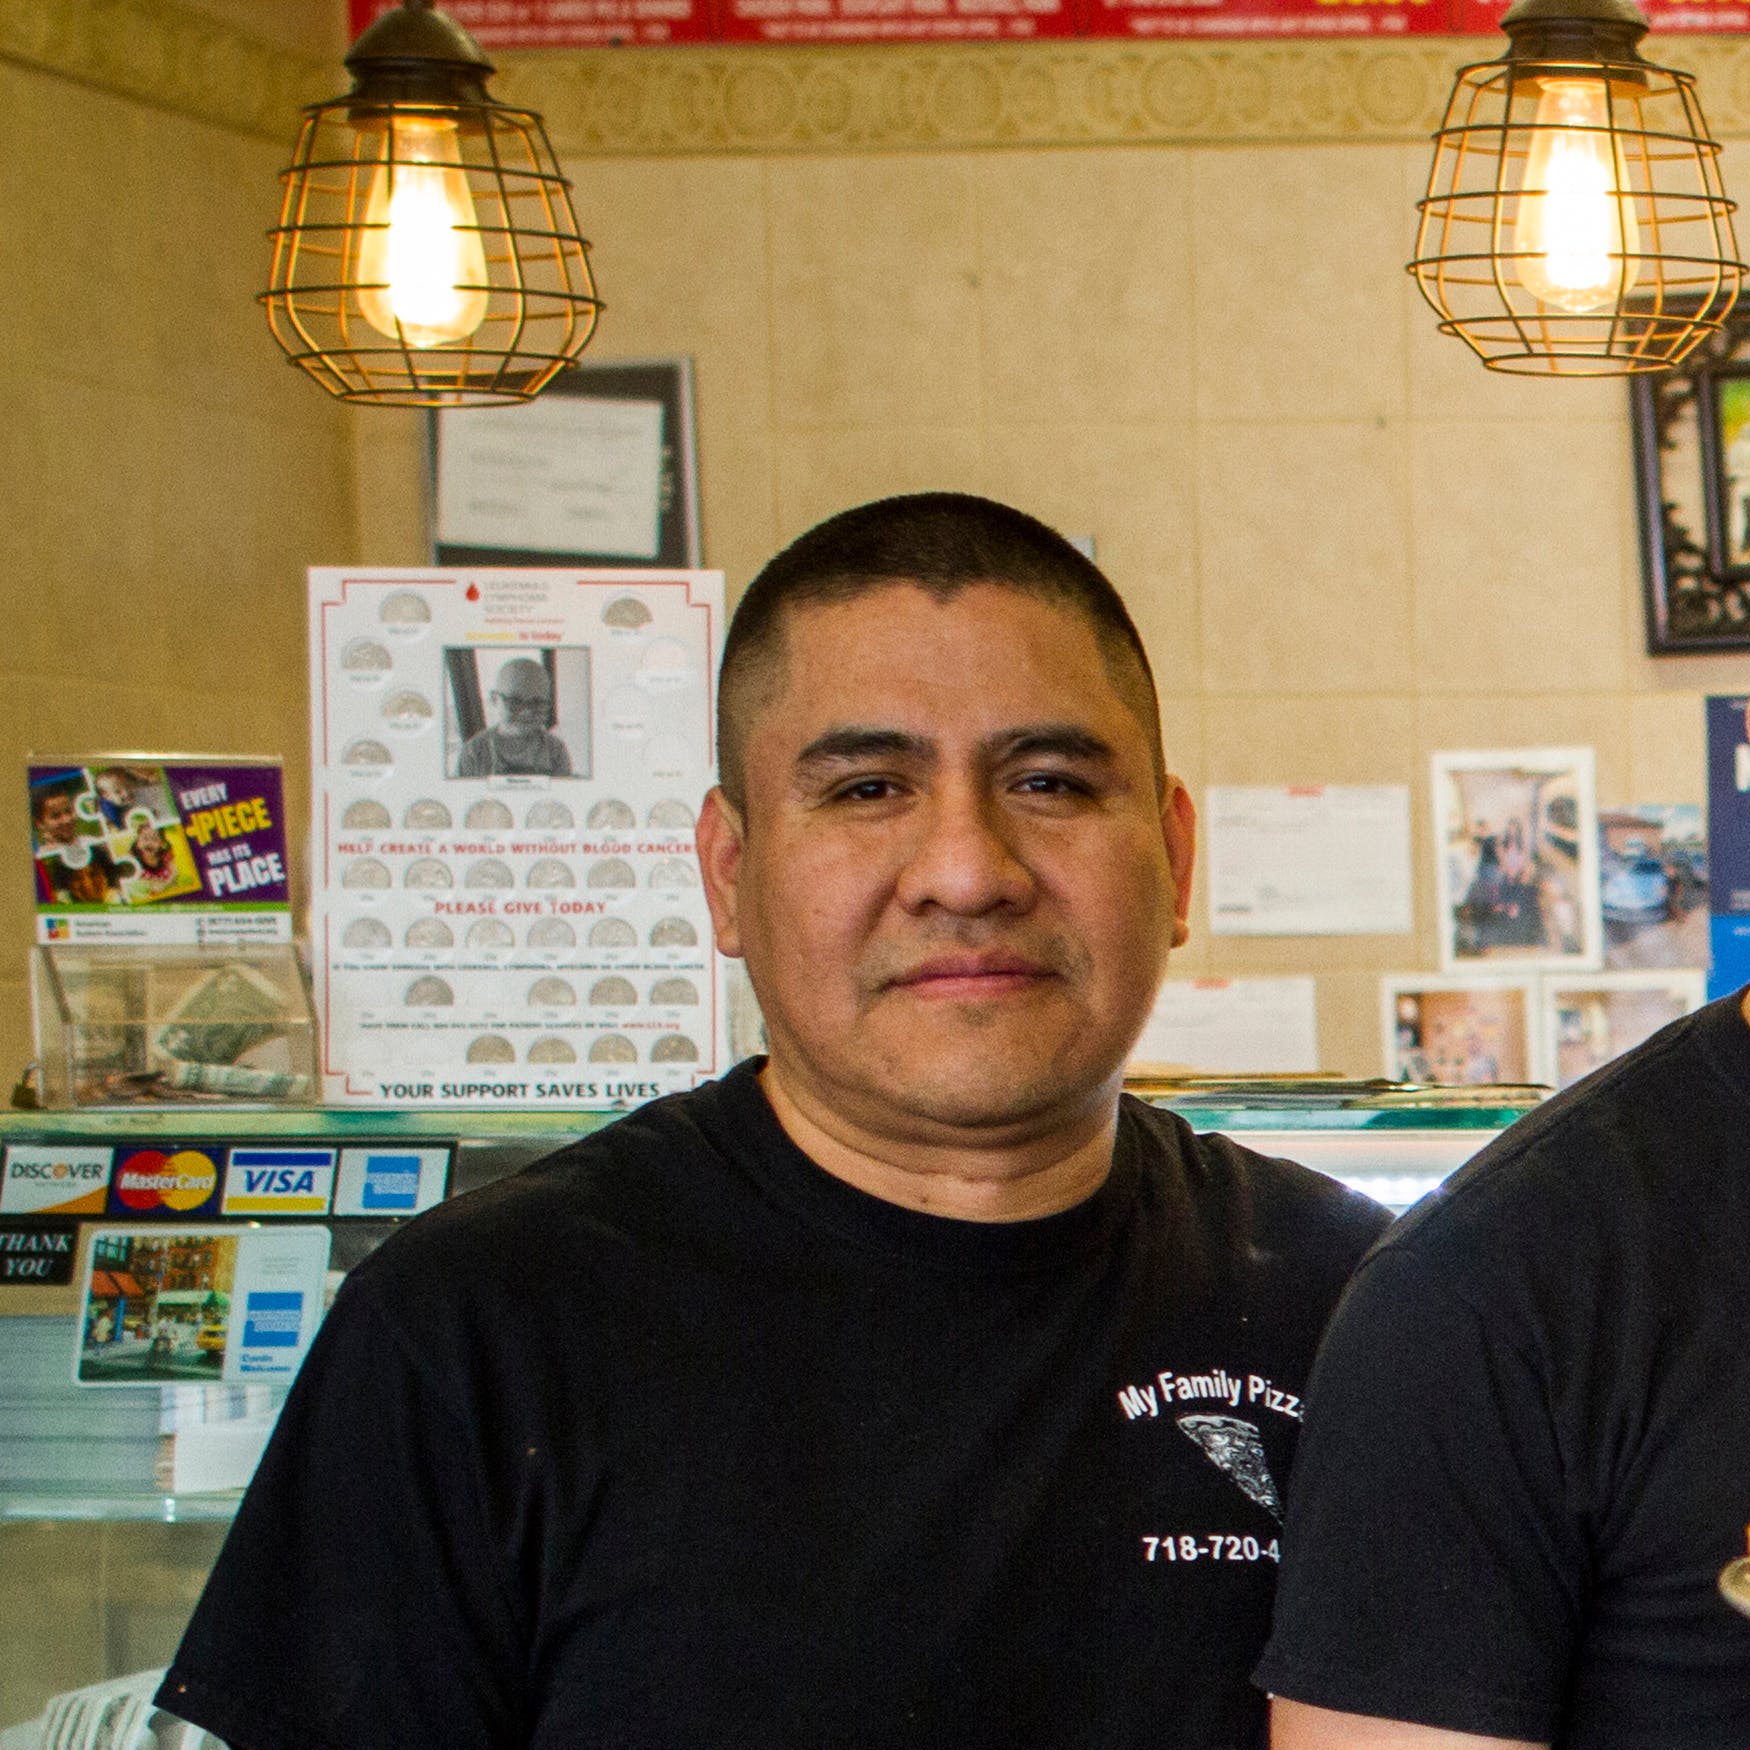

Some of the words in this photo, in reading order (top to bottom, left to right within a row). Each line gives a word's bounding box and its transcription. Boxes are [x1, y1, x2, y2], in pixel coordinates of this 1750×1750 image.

[180, 782, 228, 811] EVERY
[187, 796, 273, 847] PIECE
[338, 843, 373, 855] HELP
[380, 843, 433, 855] CREATE
[439, 843, 448, 855] A
[454, 843, 505, 855] WORLD
[511, 843, 576, 855] WITHOUT
[583, 843, 632, 855] BLOOD
[637, 843, 692, 855] CANCER
[207, 851, 286, 897] PLACE
[434, 901, 496, 915] PLEASE
[504, 901, 542, 915] GIVE
[550, 901, 607, 915] TODAY
[380, 1083, 433, 1098] YOUR
[440, 1083, 528, 1098] SUPPORT
[535, 1083, 597, 1098] SAVES
[605, 1083, 660, 1098] LIVES
[10, 1162, 103, 1181] DISCOVER
[119, 1171, 216, 1190] MasterCard
[244, 1169, 315, 1192] VISA
[0, 1232, 72, 1251] THANK
[5, 1258, 54, 1277] YOU
[1117, 1384, 1159, 1420] My
[1157, 1368, 1243, 1407] Family
[1248, 1373, 1304, 1422] Pizz
[1141, 1535, 1281, 1564] 718-720-4
